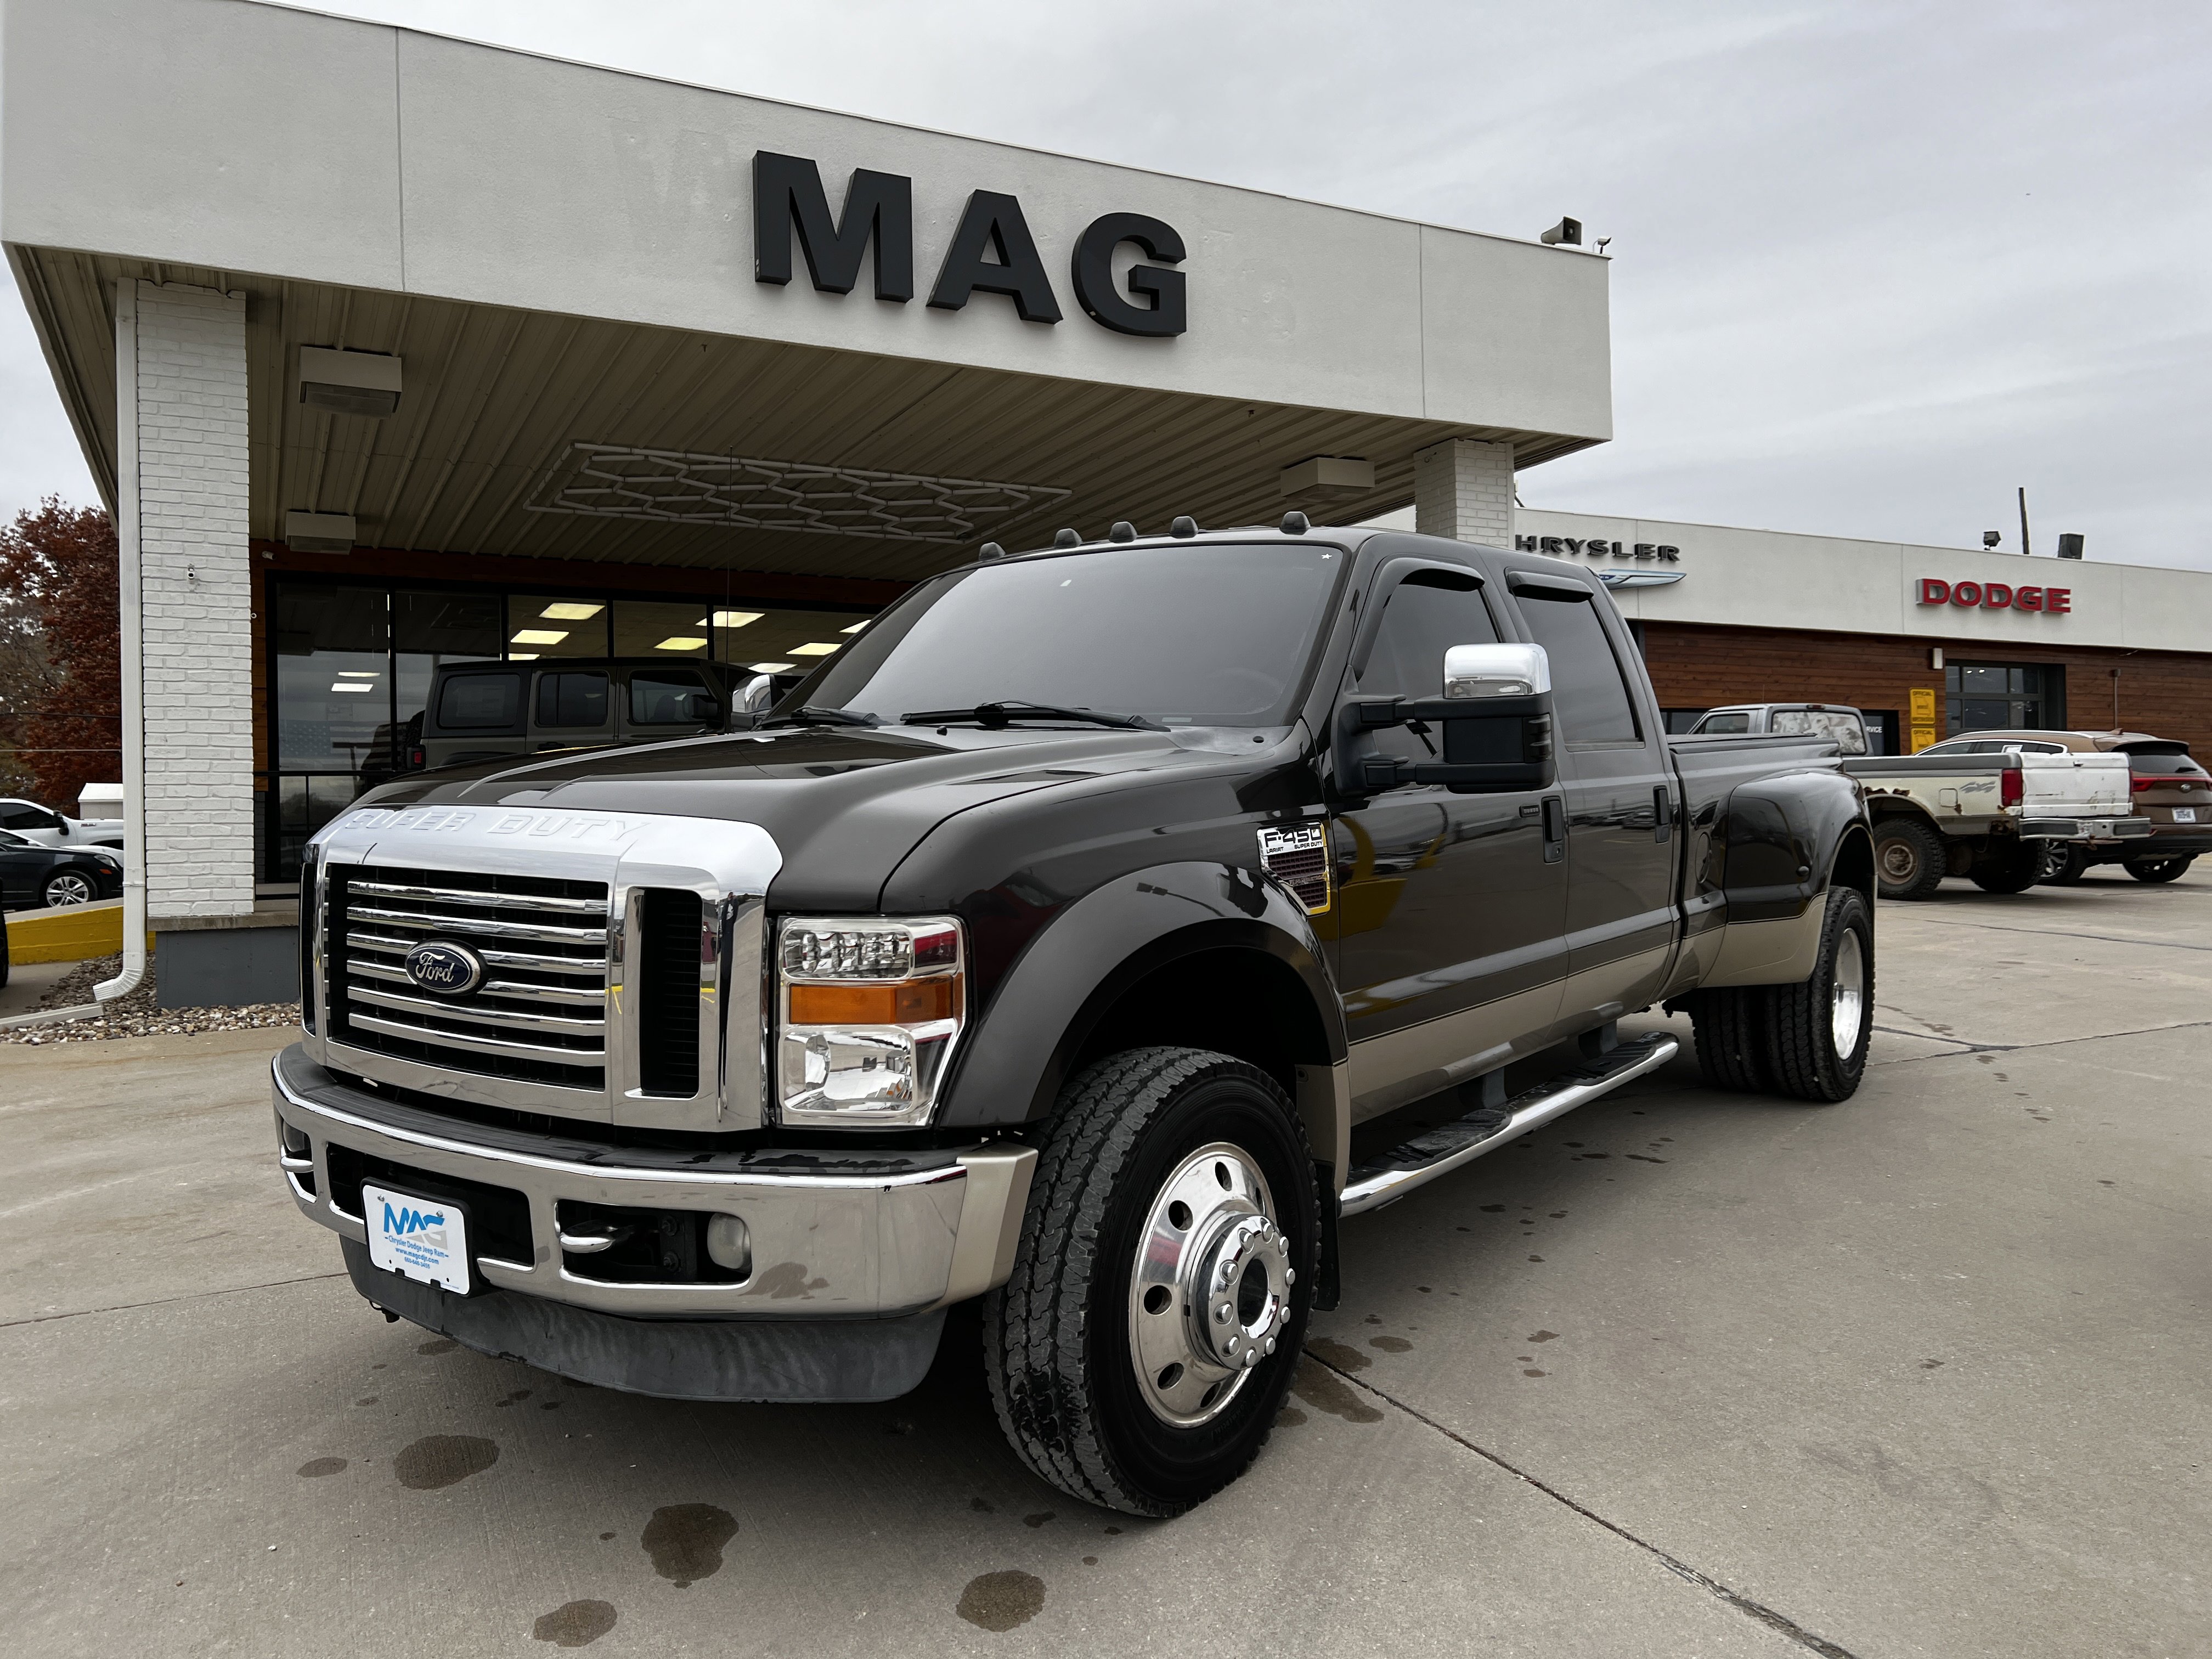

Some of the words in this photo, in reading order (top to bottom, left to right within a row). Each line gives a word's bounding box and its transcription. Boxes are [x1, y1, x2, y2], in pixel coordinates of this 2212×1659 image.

[752, 150, 1187, 337] MAG
[1515, 534, 1680, 561] HRYSLER
[1916, 578, 2071, 613] DODGE
[345, 811, 476, 831] SUPER
[487, 814, 652, 841] DUTY
[1264, 825, 1322, 848] F-450
[415, 951, 455, 983] Ford
[388, 1235, 406, 1246] Chrysler
[407, 1240, 422, 1252] Dodge
[422, 1245, 433, 1255] Jeep
[433, 1249, 445, 1258] Ram
